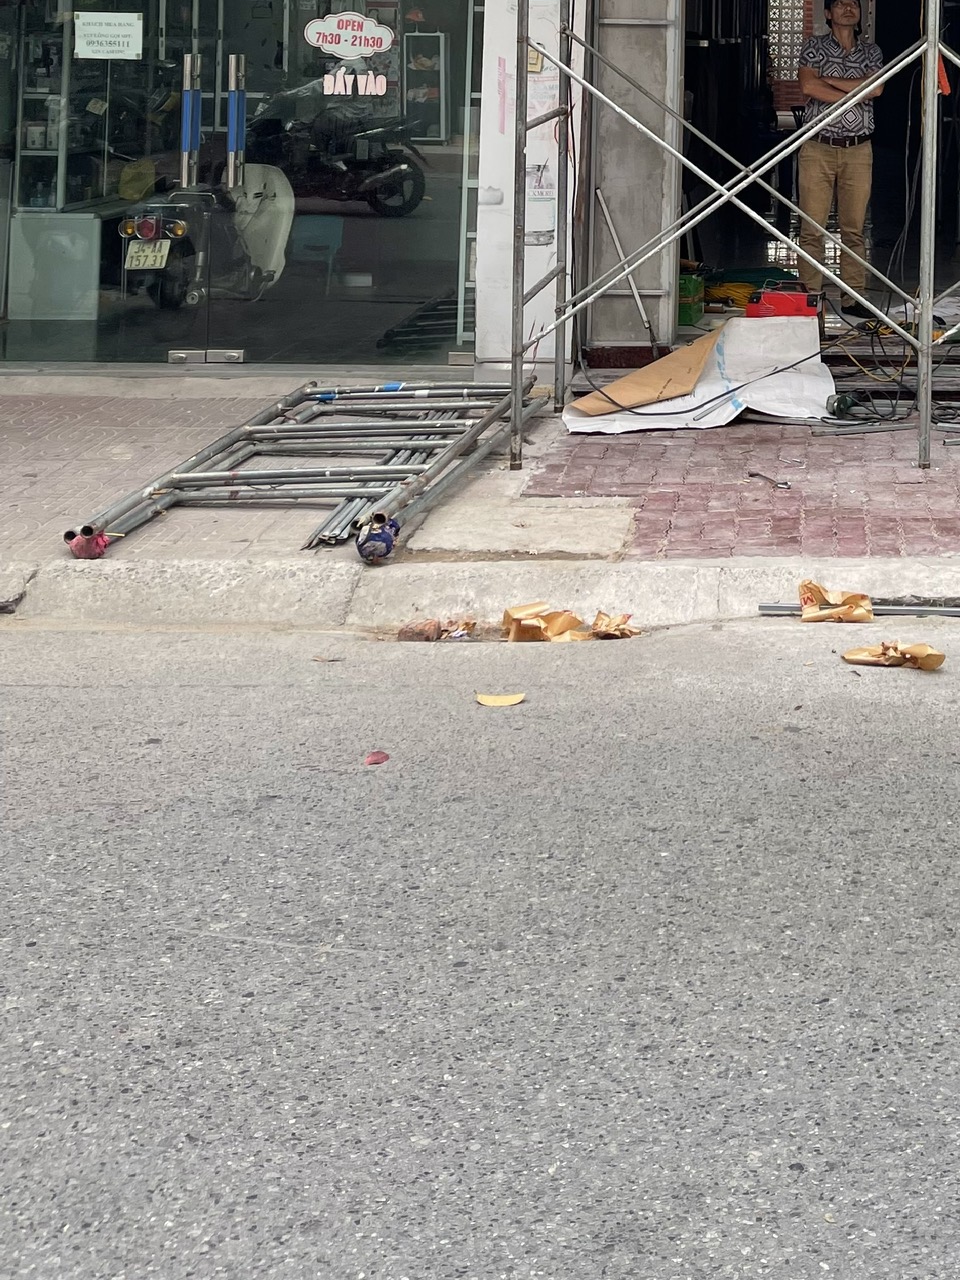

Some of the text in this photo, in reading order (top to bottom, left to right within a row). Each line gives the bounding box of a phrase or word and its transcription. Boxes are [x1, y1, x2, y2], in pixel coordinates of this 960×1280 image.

[337, 19, 364, 32] OPEN
[316, 32, 341, 45] 7h30
[351, 35, 383, 48] 21h30
[357, 71, 387, 96] VÀO
